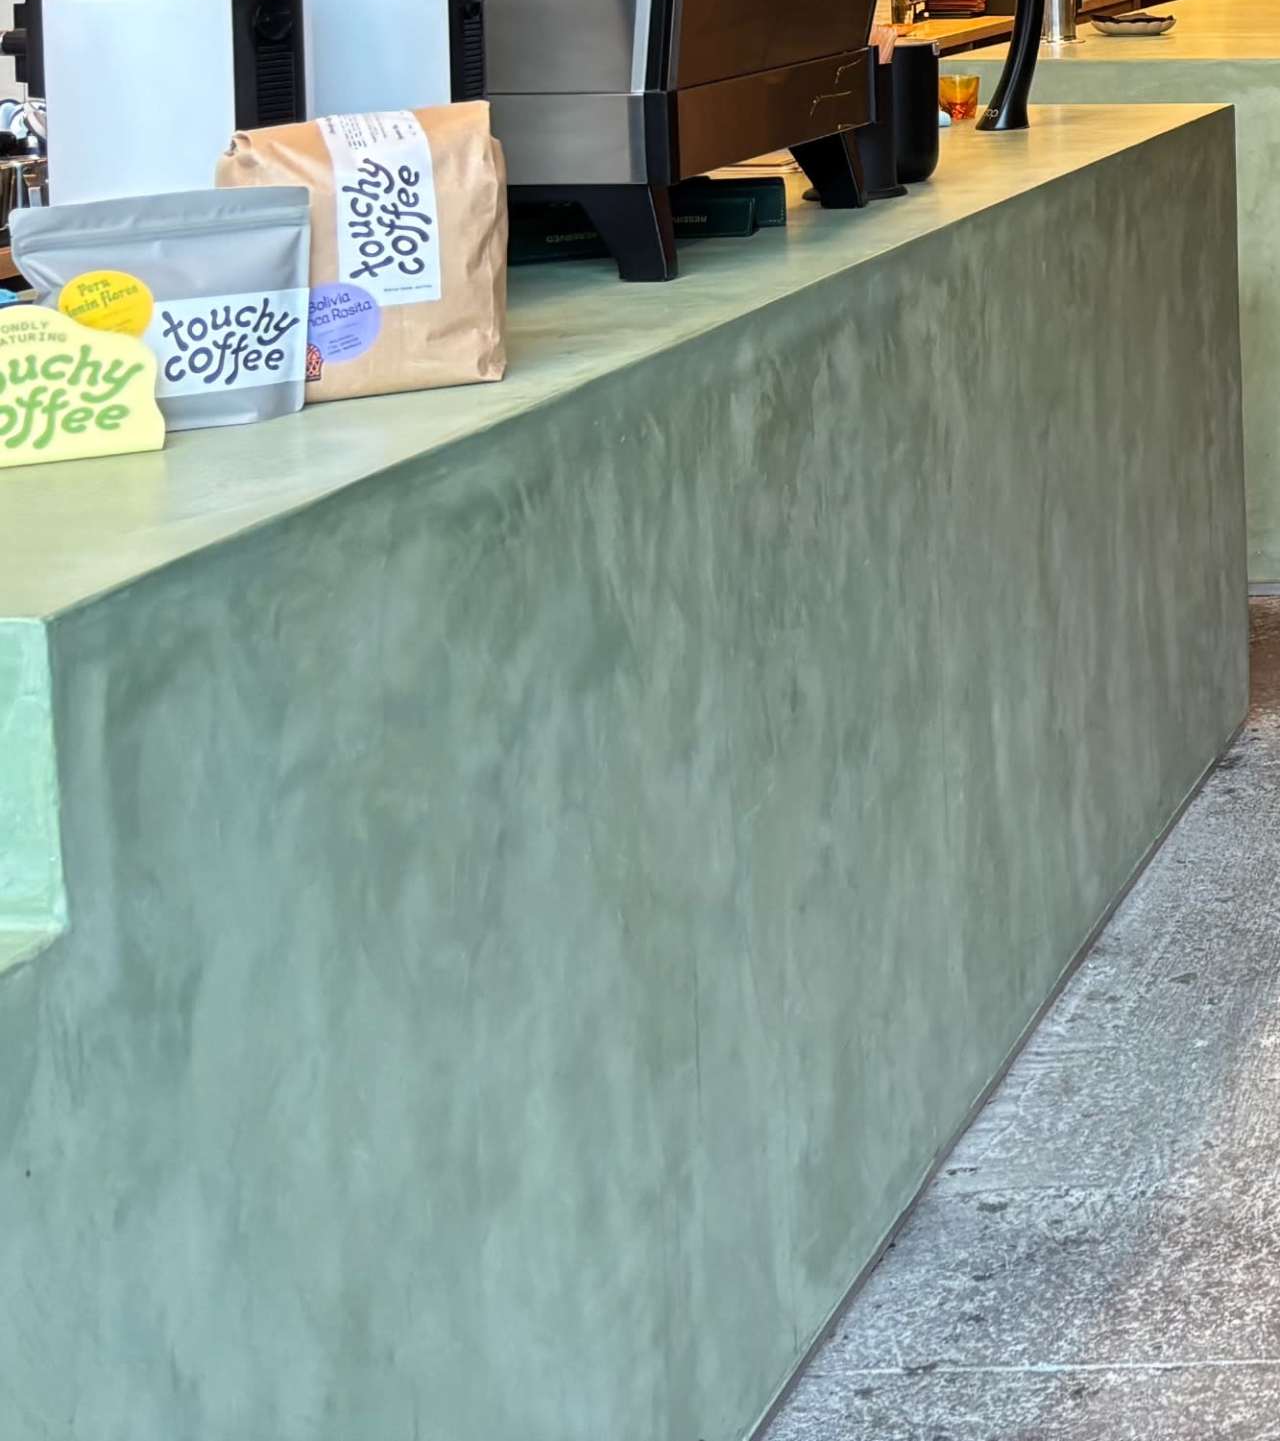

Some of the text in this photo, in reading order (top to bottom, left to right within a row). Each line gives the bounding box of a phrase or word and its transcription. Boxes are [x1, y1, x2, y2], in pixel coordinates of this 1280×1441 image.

[341, 157, 395, 279] touchy
[377, 165, 432, 275] coffee
[161, 297, 301, 352] touchy
[331, 300, 373, 321] Rosita
[164, 331, 285, 385] coffee
